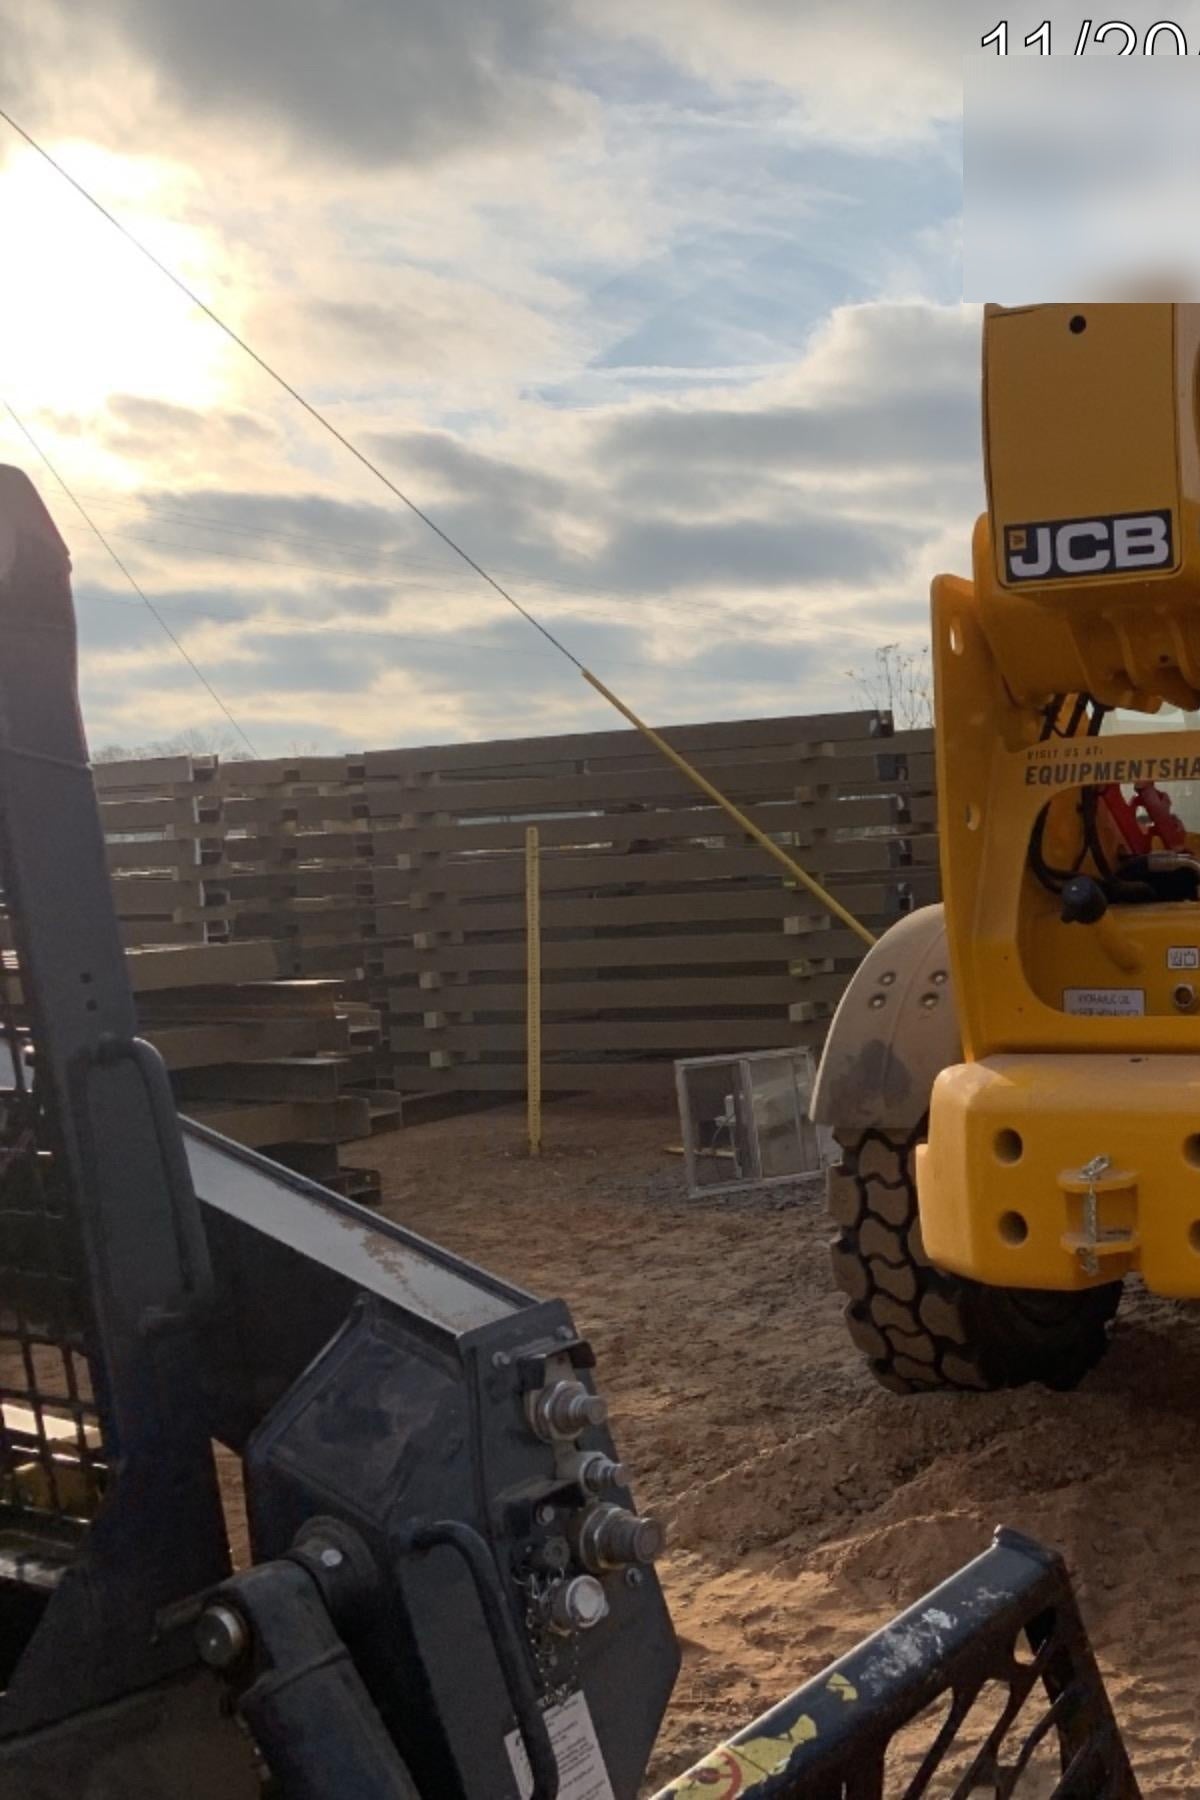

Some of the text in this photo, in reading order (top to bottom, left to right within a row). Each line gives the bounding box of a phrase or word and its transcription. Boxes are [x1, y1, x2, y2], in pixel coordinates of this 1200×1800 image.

[1008, 515, 1169, 577] JCB
[1026, 748, 1058, 761] VISIT
[1063, 747, 1079, 758] US
